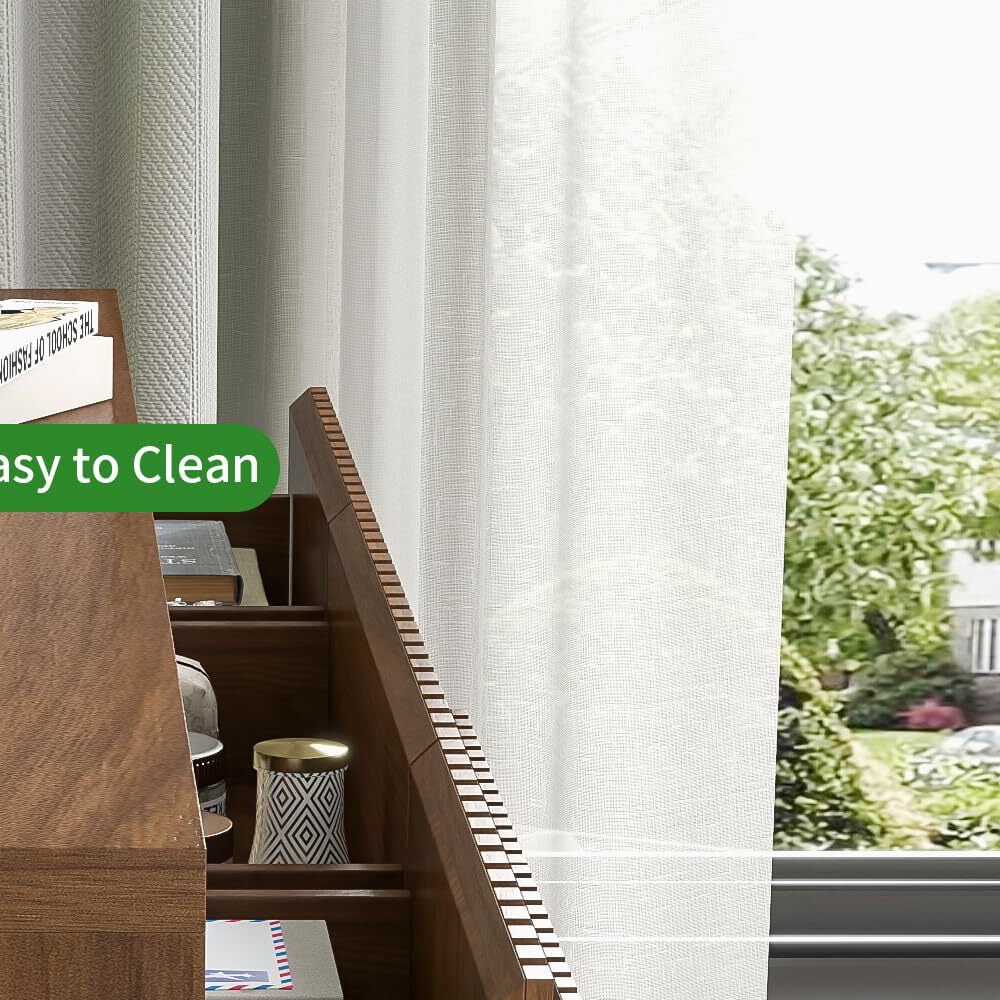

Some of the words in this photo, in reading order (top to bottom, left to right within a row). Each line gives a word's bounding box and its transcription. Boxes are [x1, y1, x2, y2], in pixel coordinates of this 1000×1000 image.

[46, 317, 79, 357] SCHOOL
[79, 308, 95, 340] THE
[34, 335, 45, 365] OF
